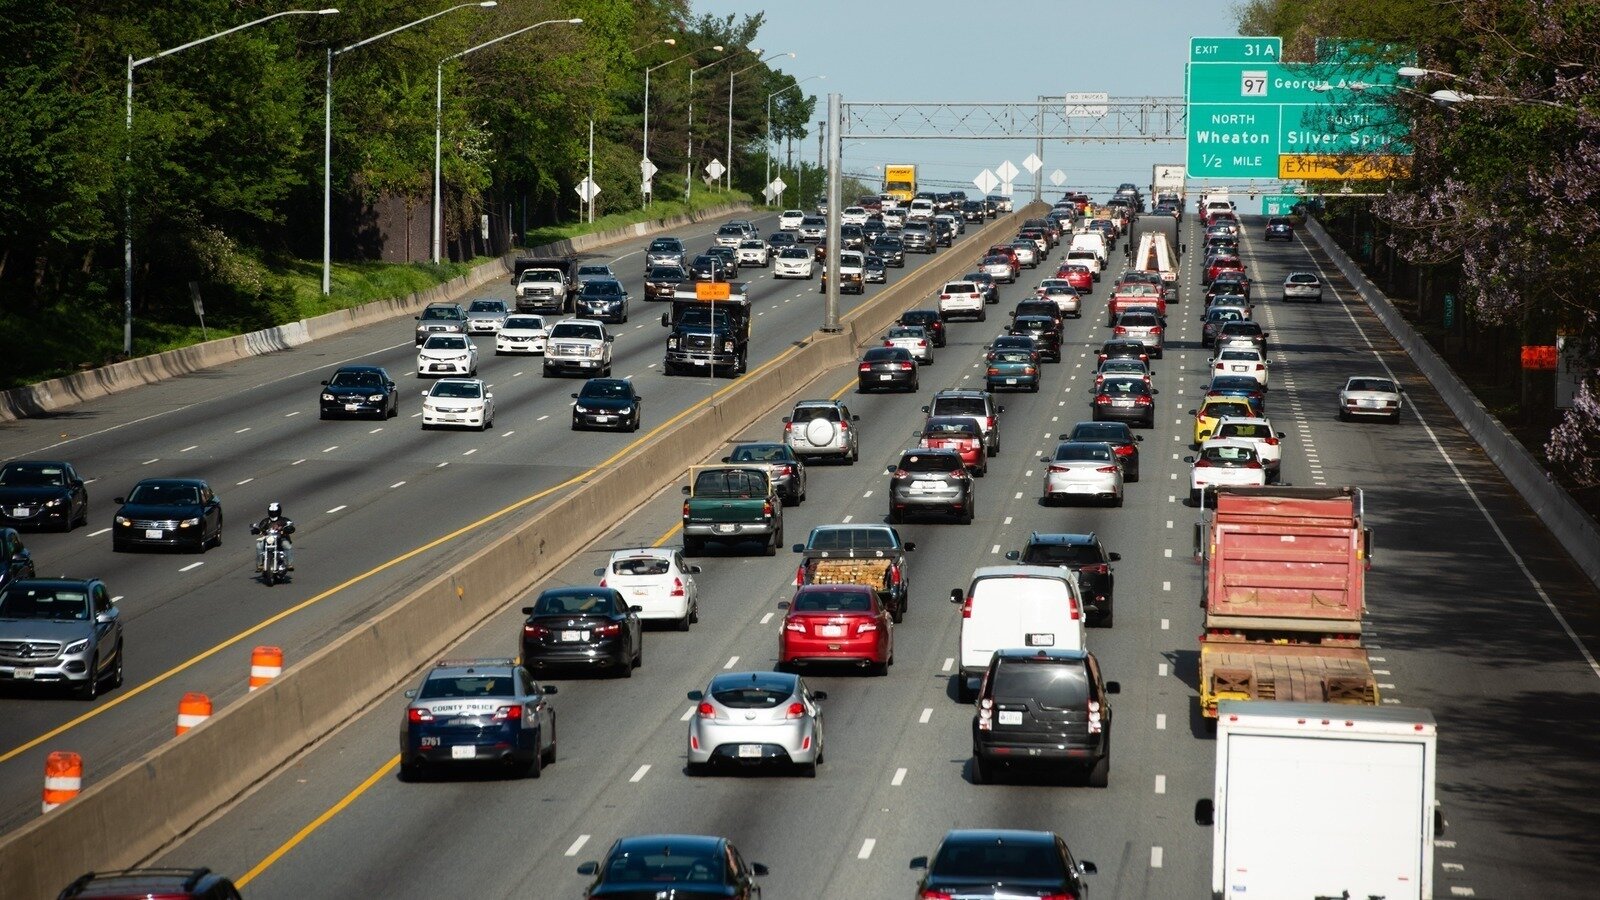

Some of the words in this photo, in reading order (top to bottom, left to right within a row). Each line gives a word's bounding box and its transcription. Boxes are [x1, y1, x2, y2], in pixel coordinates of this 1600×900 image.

[1195, 45, 1219, 54] EXIT
[1244, 79, 1265, 93] 97
[1212, 114, 1255, 124] NORTH
[1196, 130, 1269, 144] Wheaton
[1287, 131, 1339, 144] Silver
[1233, 156, 1262, 166] MILE
[1286, 161, 1319, 173] EXIT
[432, 704, 463, 713] COUNTY
